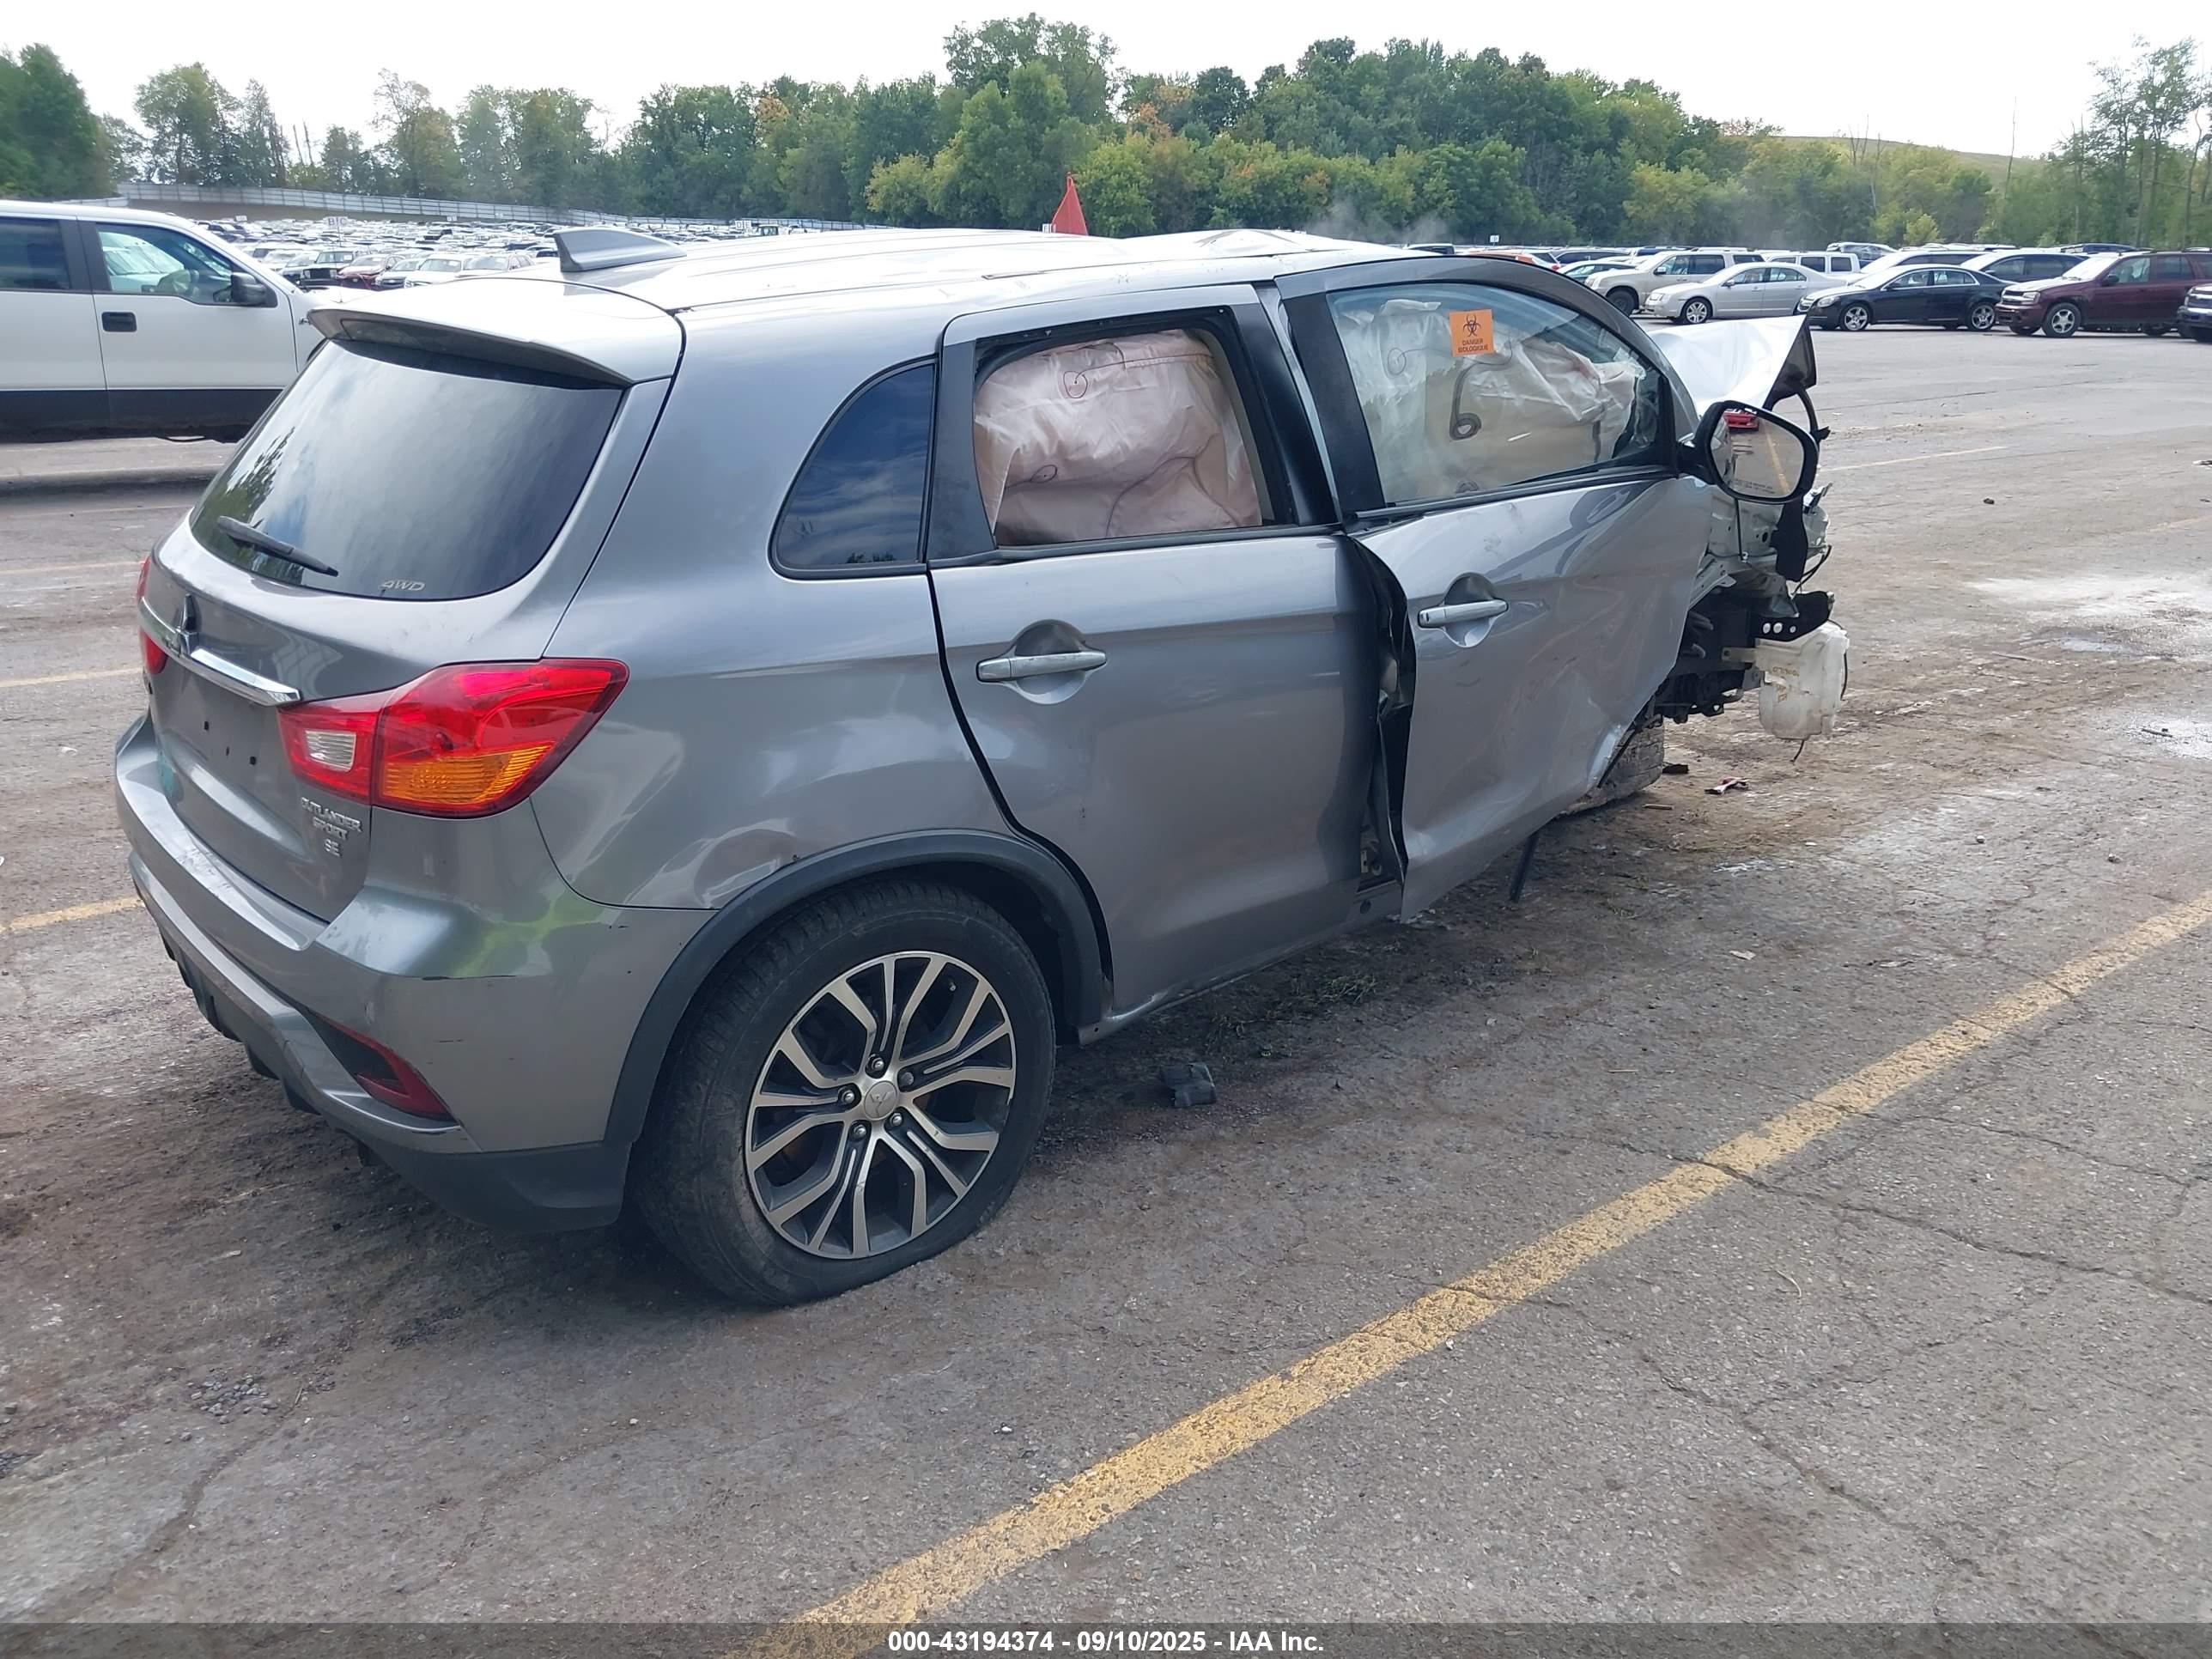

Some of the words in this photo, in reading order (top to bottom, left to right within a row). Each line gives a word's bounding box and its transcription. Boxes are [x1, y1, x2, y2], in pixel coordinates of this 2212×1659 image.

[1462, 337, 1484, 346] DANGER
[378, 580, 426, 591] 4WD
[301, 796, 362, 833] OUTLANDER
[313, 817, 349, 841] SPORT
[325, 838, 341, 858] SE
